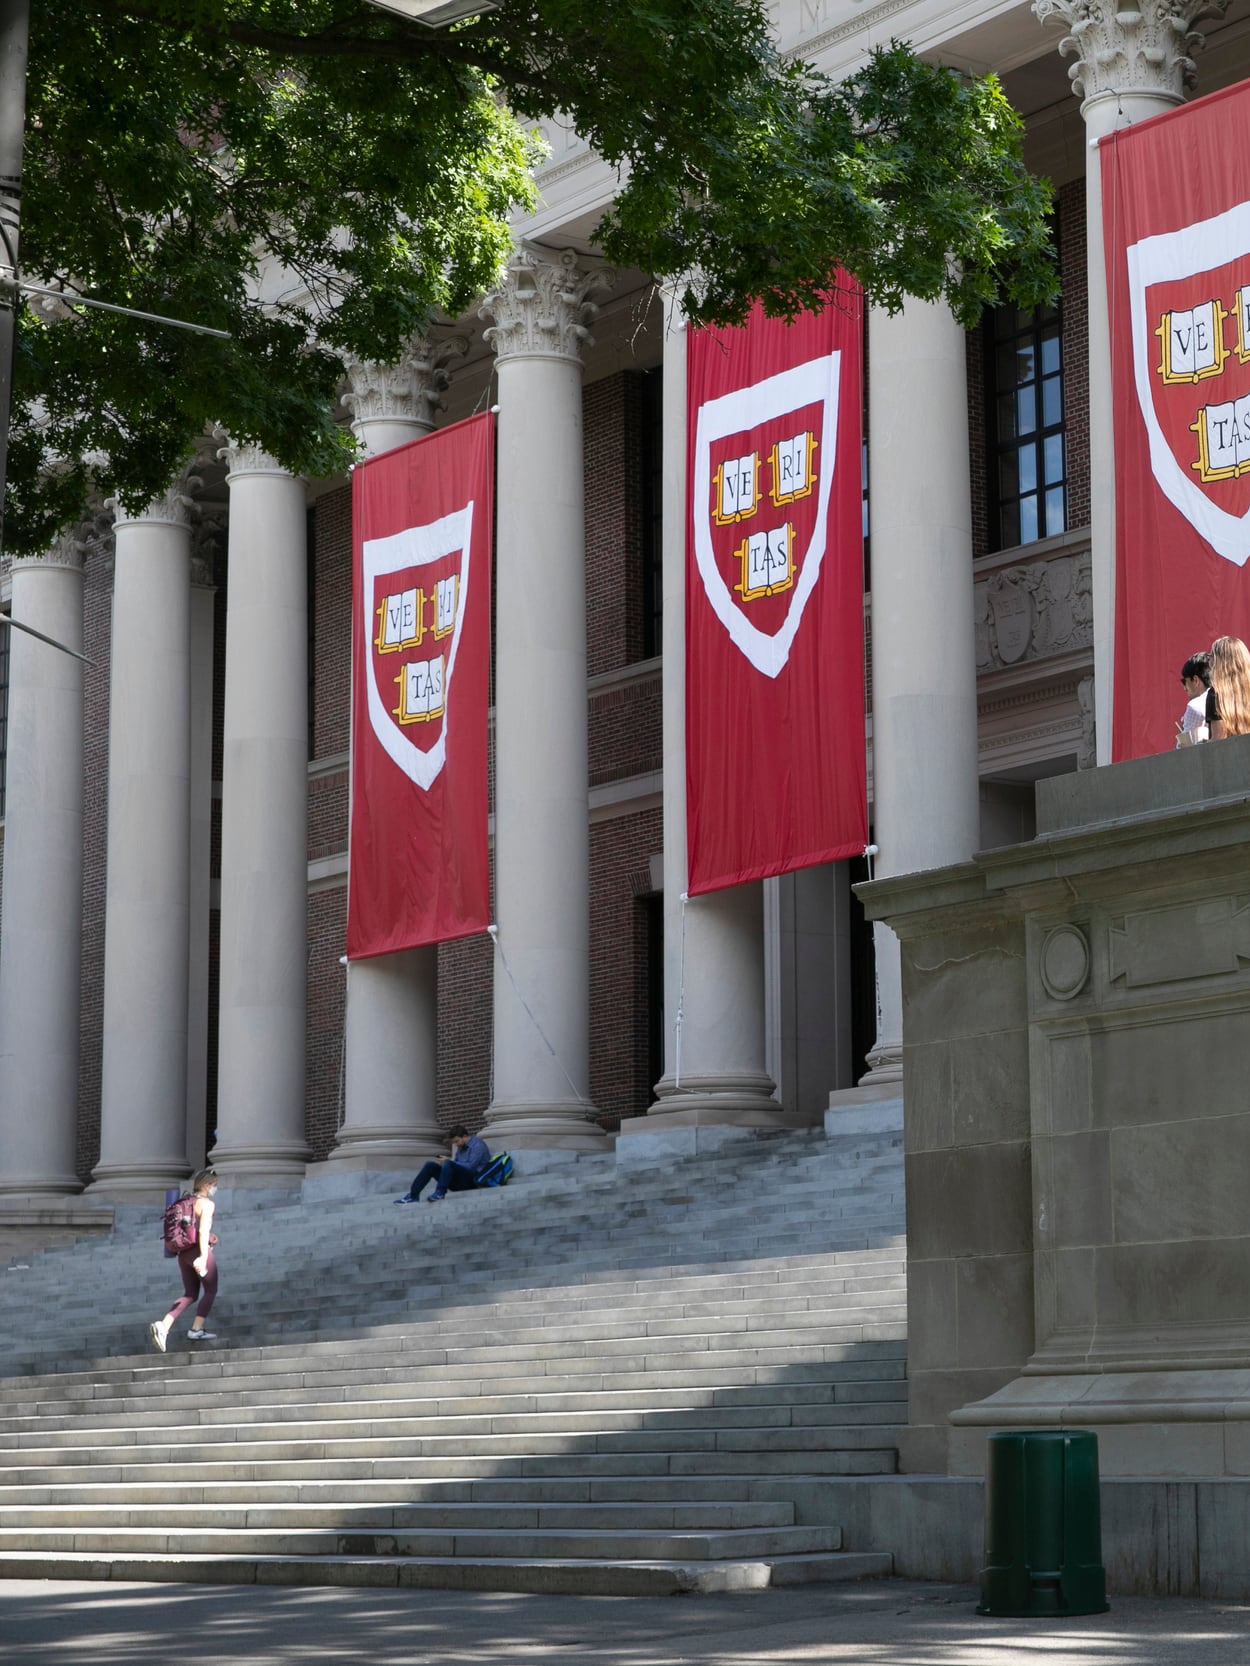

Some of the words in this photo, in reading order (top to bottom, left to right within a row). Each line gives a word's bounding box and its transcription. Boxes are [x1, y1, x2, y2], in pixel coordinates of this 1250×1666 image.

[1173, 322, 1209, 356] VE
[725, 470, 752, 499] VE
[782, 449, 803, 481] RI
[750, 540, 787, 573] TAS
[389, 603, 413, 630] VE
[411, 669, 442, 699] TAS
